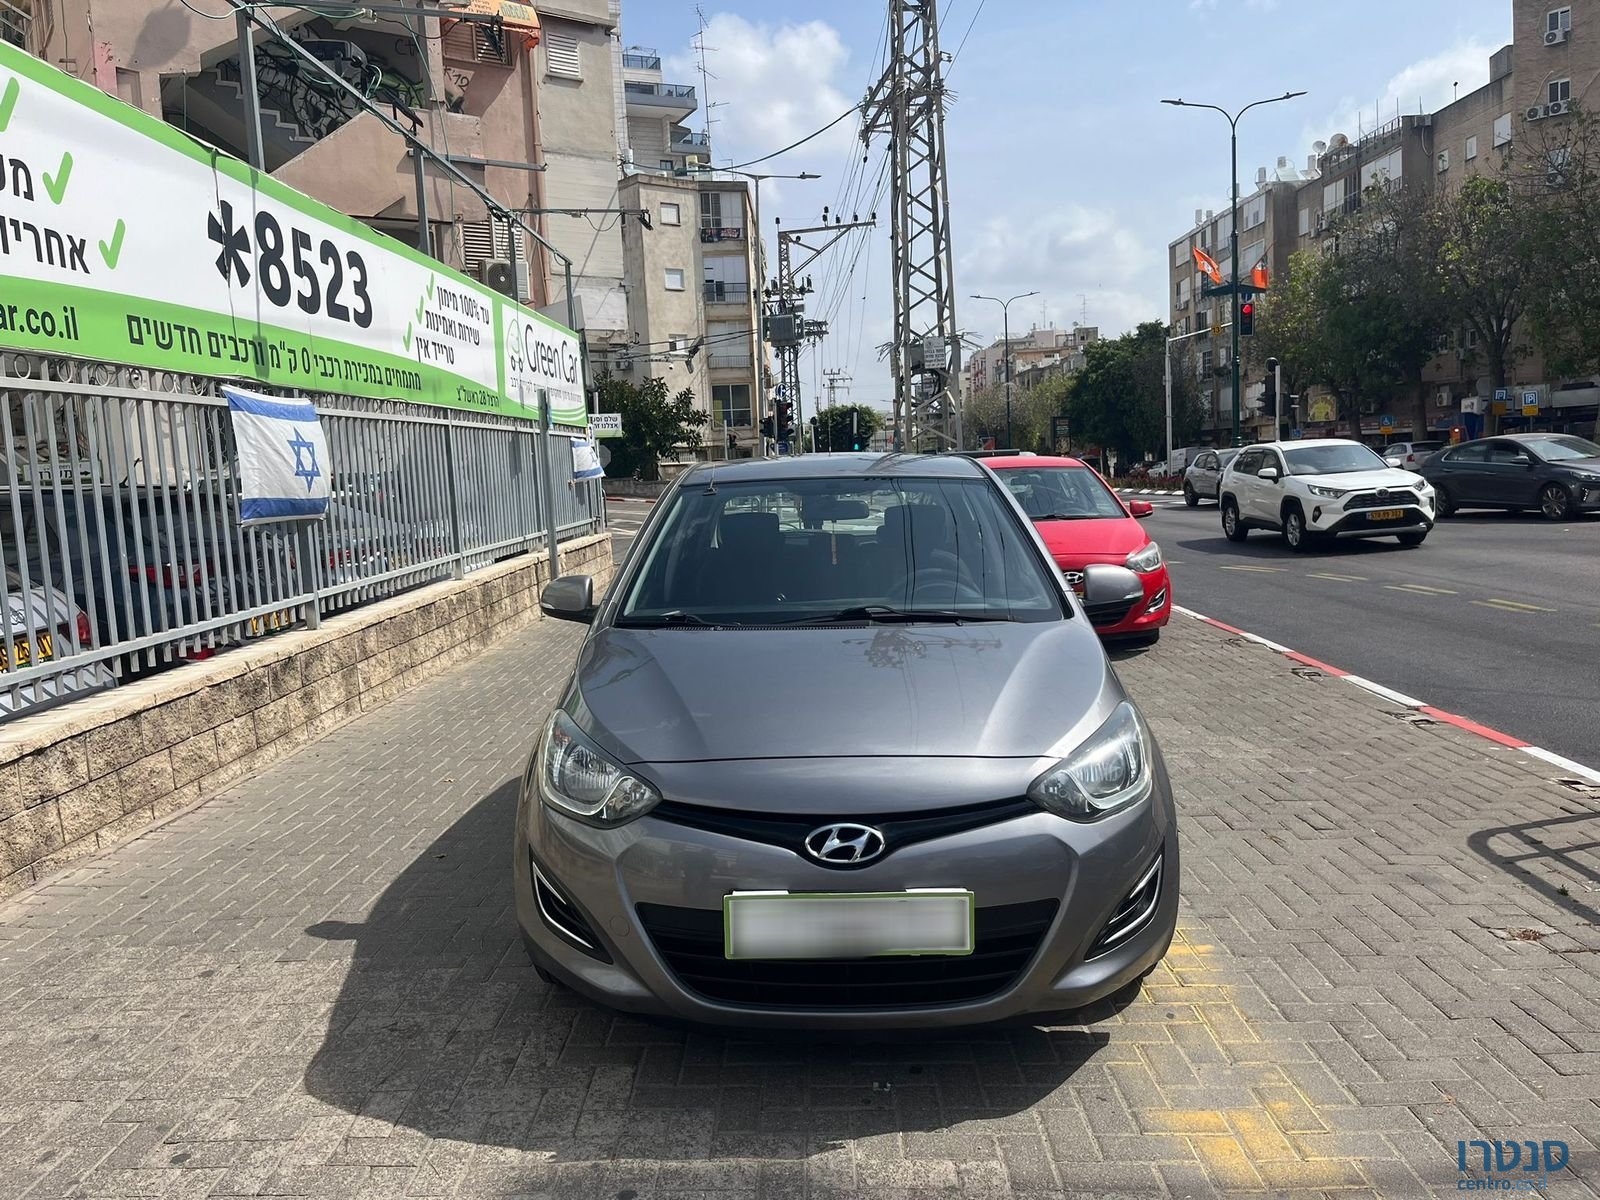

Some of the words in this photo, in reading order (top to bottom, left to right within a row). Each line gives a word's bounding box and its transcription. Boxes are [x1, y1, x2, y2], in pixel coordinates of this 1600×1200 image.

[437, 286, 458, 311] מימון
[460, 294, 479, 321] 100%
[425, 310, 457, 338] ואמינות
[480, 306, 489, 325] עד
[126, 314, 203, 356] חדשים
[458, 322, 480, 346] שירות
[207, 331, 265, 366] ורכבים
[301, 347, 311, 374] 0
[416, 337, 430, 363] אין
[432, 341, 454, 365] טרייד
[525, 324, 562, 379] Green
[562, 340, 578, 384] Car
[313, 354, 342, 379] רכבי
[344, 359, 383, 385] במכירת
[384, 367, 422, 390] מתמחים
[604, 415, 618, 423] שלם
